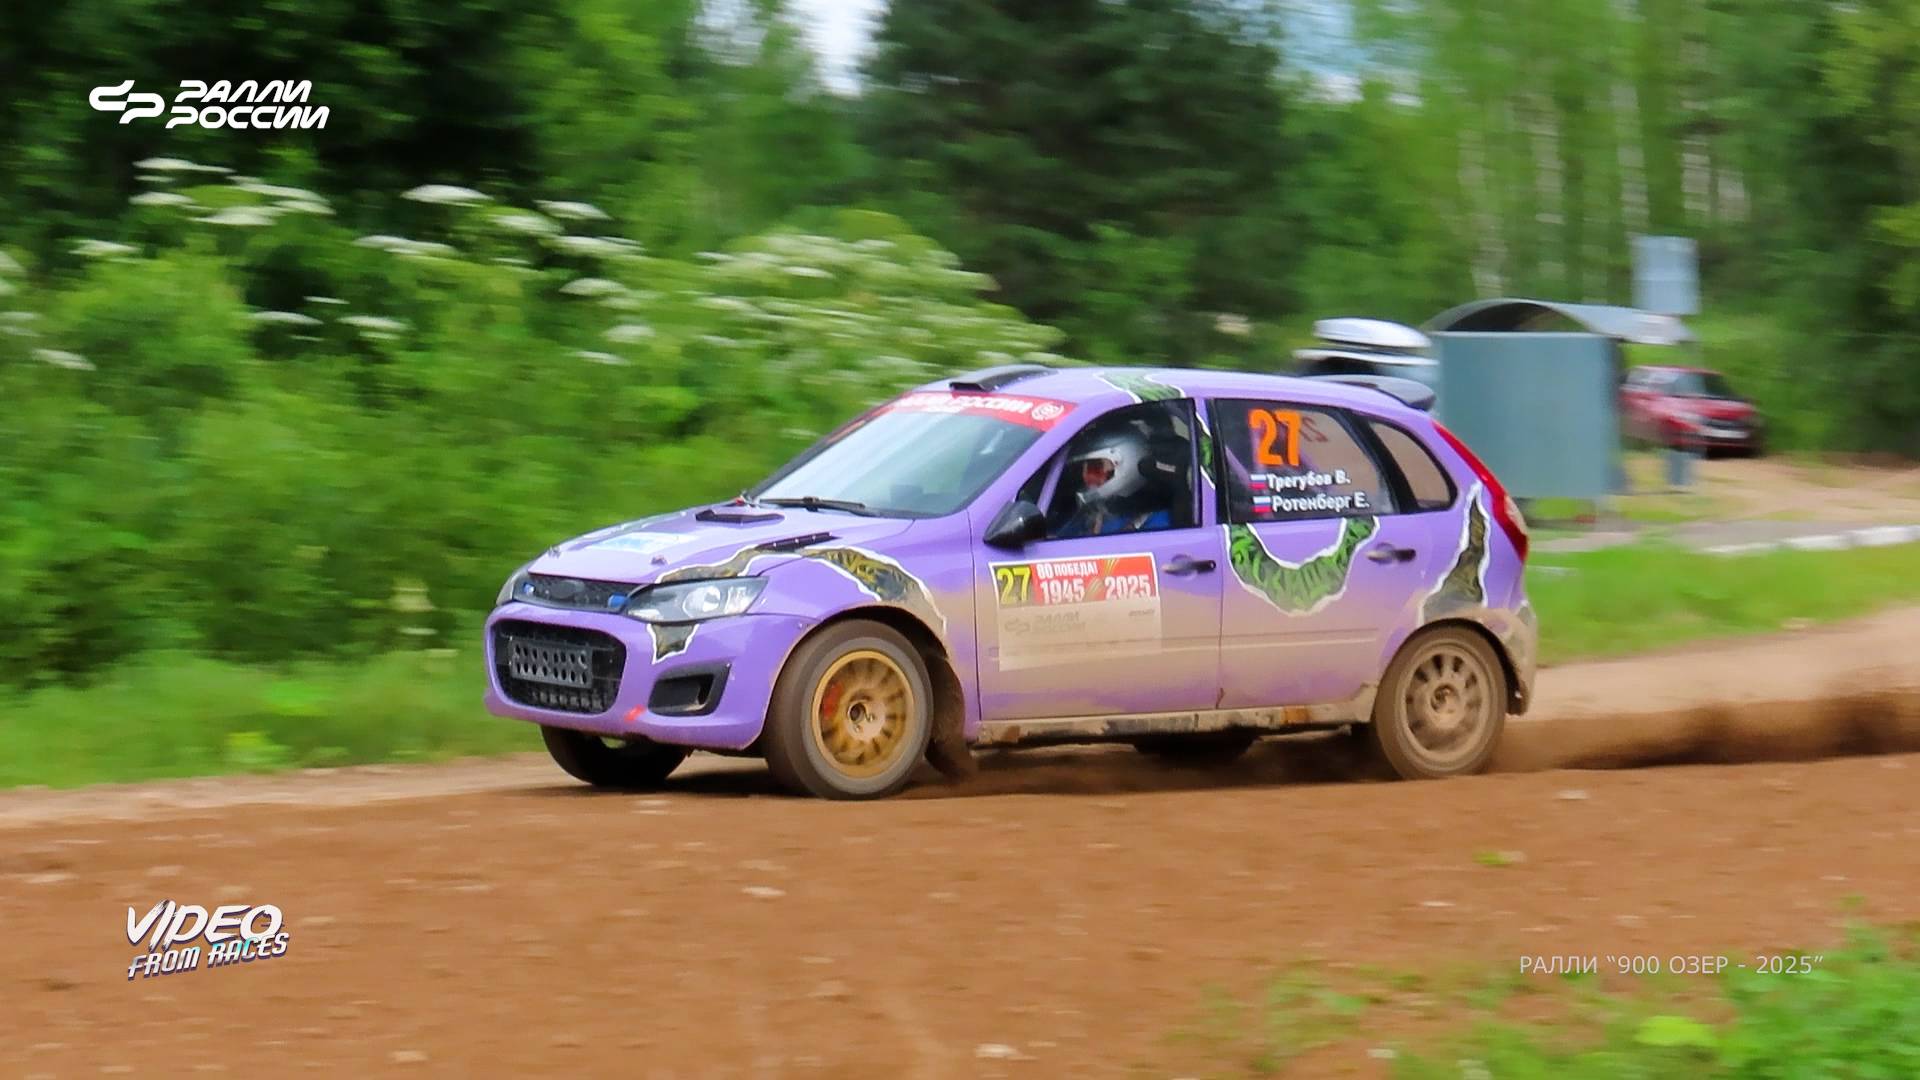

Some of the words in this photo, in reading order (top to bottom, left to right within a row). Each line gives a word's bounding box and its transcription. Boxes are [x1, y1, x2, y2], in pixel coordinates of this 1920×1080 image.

[1248, 408, 1301, 467] 27
[1267, 471, 1332, 492] Трегубов
[1334, 470, 1351, 485] В.
[1272, 493, 1352, 512] Ротенберг
[1353, 491, 1370, 508] Е.
[1053, 561, 1098, 577] ПОБЕДА!
[996, 566, 1032, 605] 27
[1039, 578, 1085, 605] 1945
[1104, 574, 1150, 600] 2025
